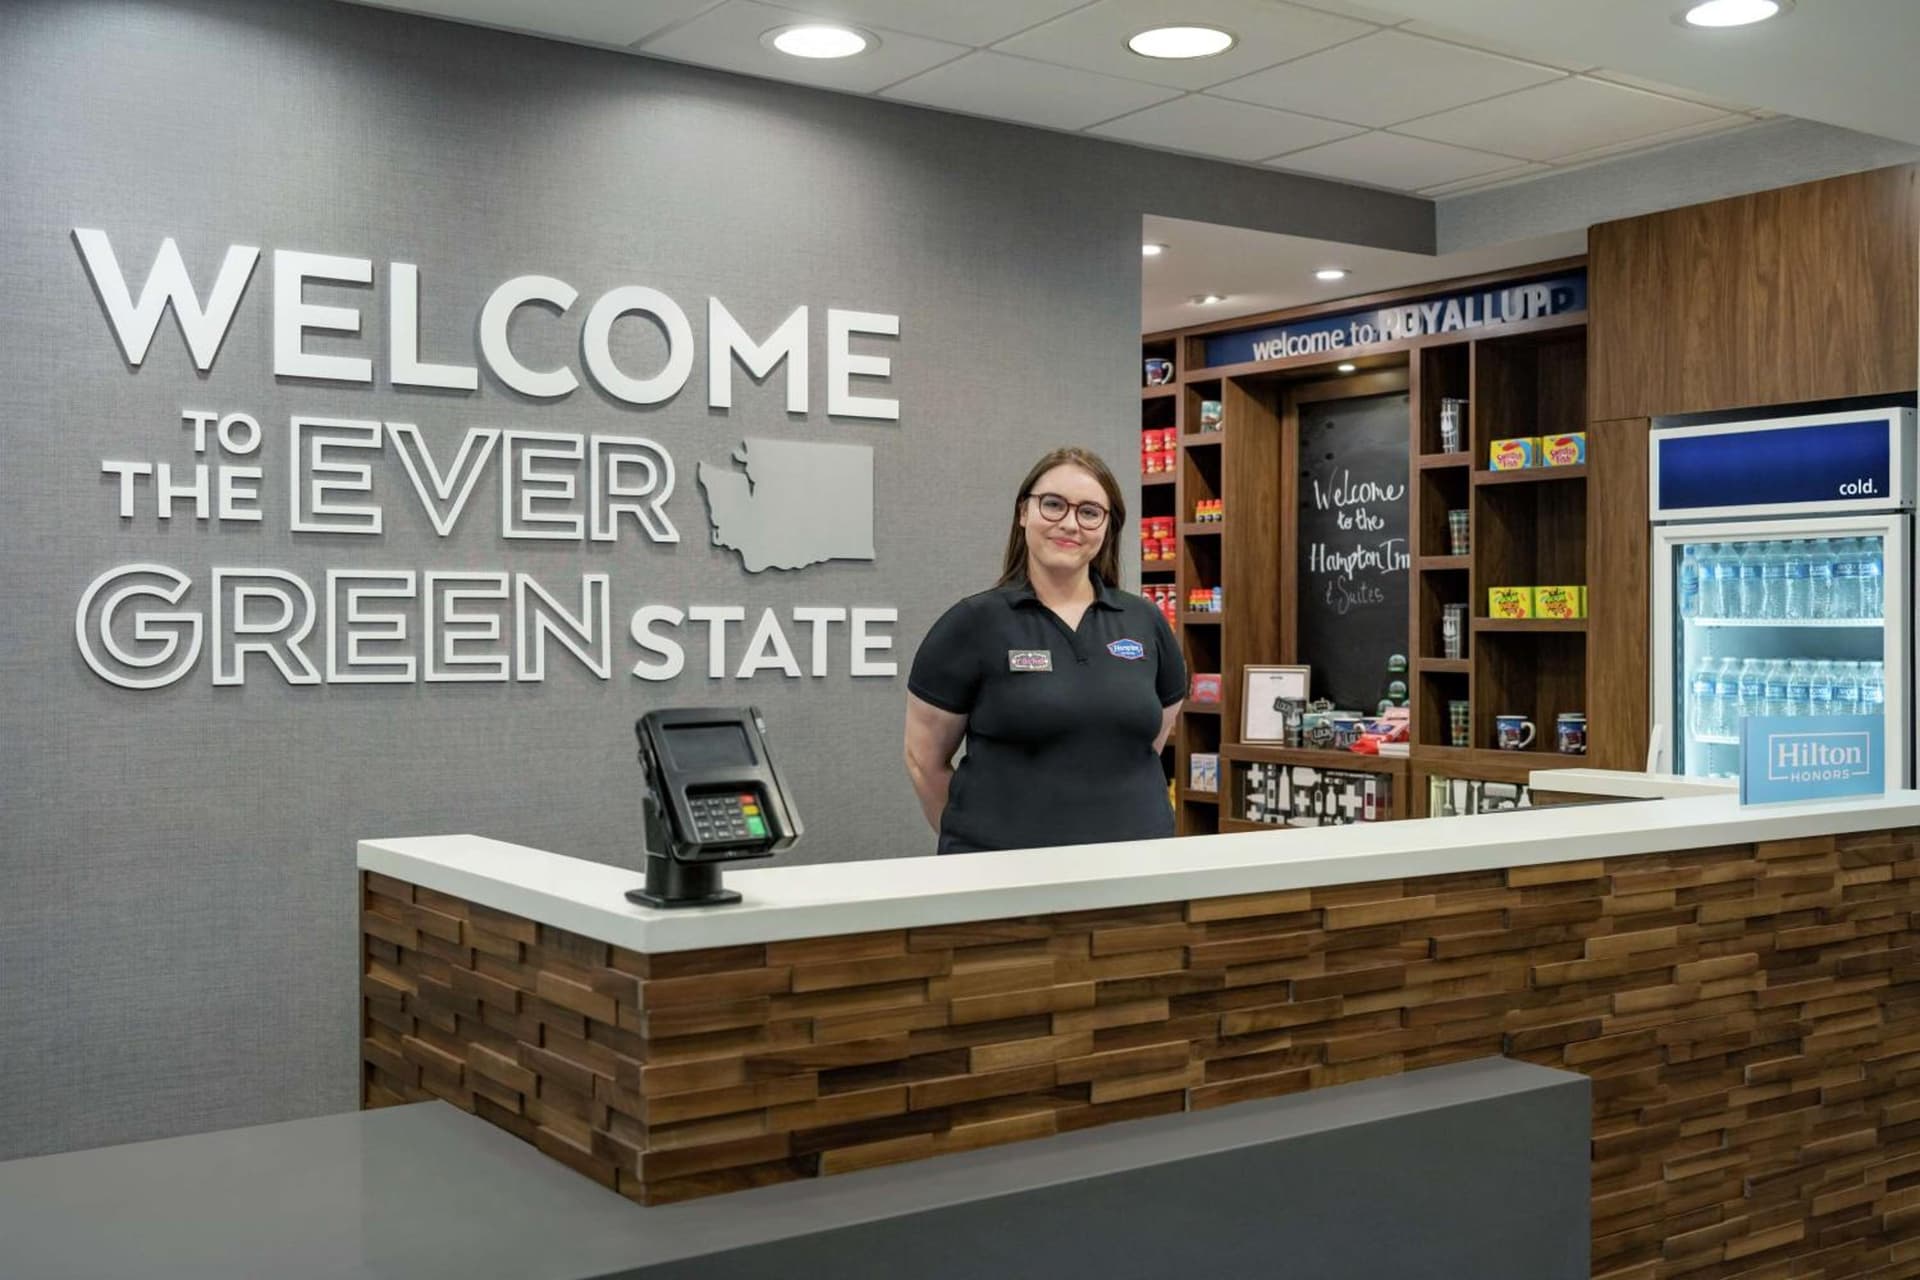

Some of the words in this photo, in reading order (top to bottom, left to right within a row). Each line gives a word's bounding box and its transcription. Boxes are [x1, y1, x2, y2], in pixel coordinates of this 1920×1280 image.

[71, 227, 899, 420] WELCOME
[1252, 330, 1345, 362] welcome
[1350, 321, 1373, 347] to
[182, 410, 262, 455] TO
[102, 460, 263, 521] THE
[290, 415, 681, 544] EVER
[1313, 467, 1405, 510] Welcome
[1838, 478, 1879, 496] cold.
[1337, 511, 1353, 530] to
[1355, 507, 1385, 531] the
[1309, 543, 1384, 580] Hampton
[75, 563, 612, 689] GREEN
[630, 605, 898, 681] STATE
[1777, 741, 1863, 768] Hilton
[1790, 769, 1850, 783] HONORS
